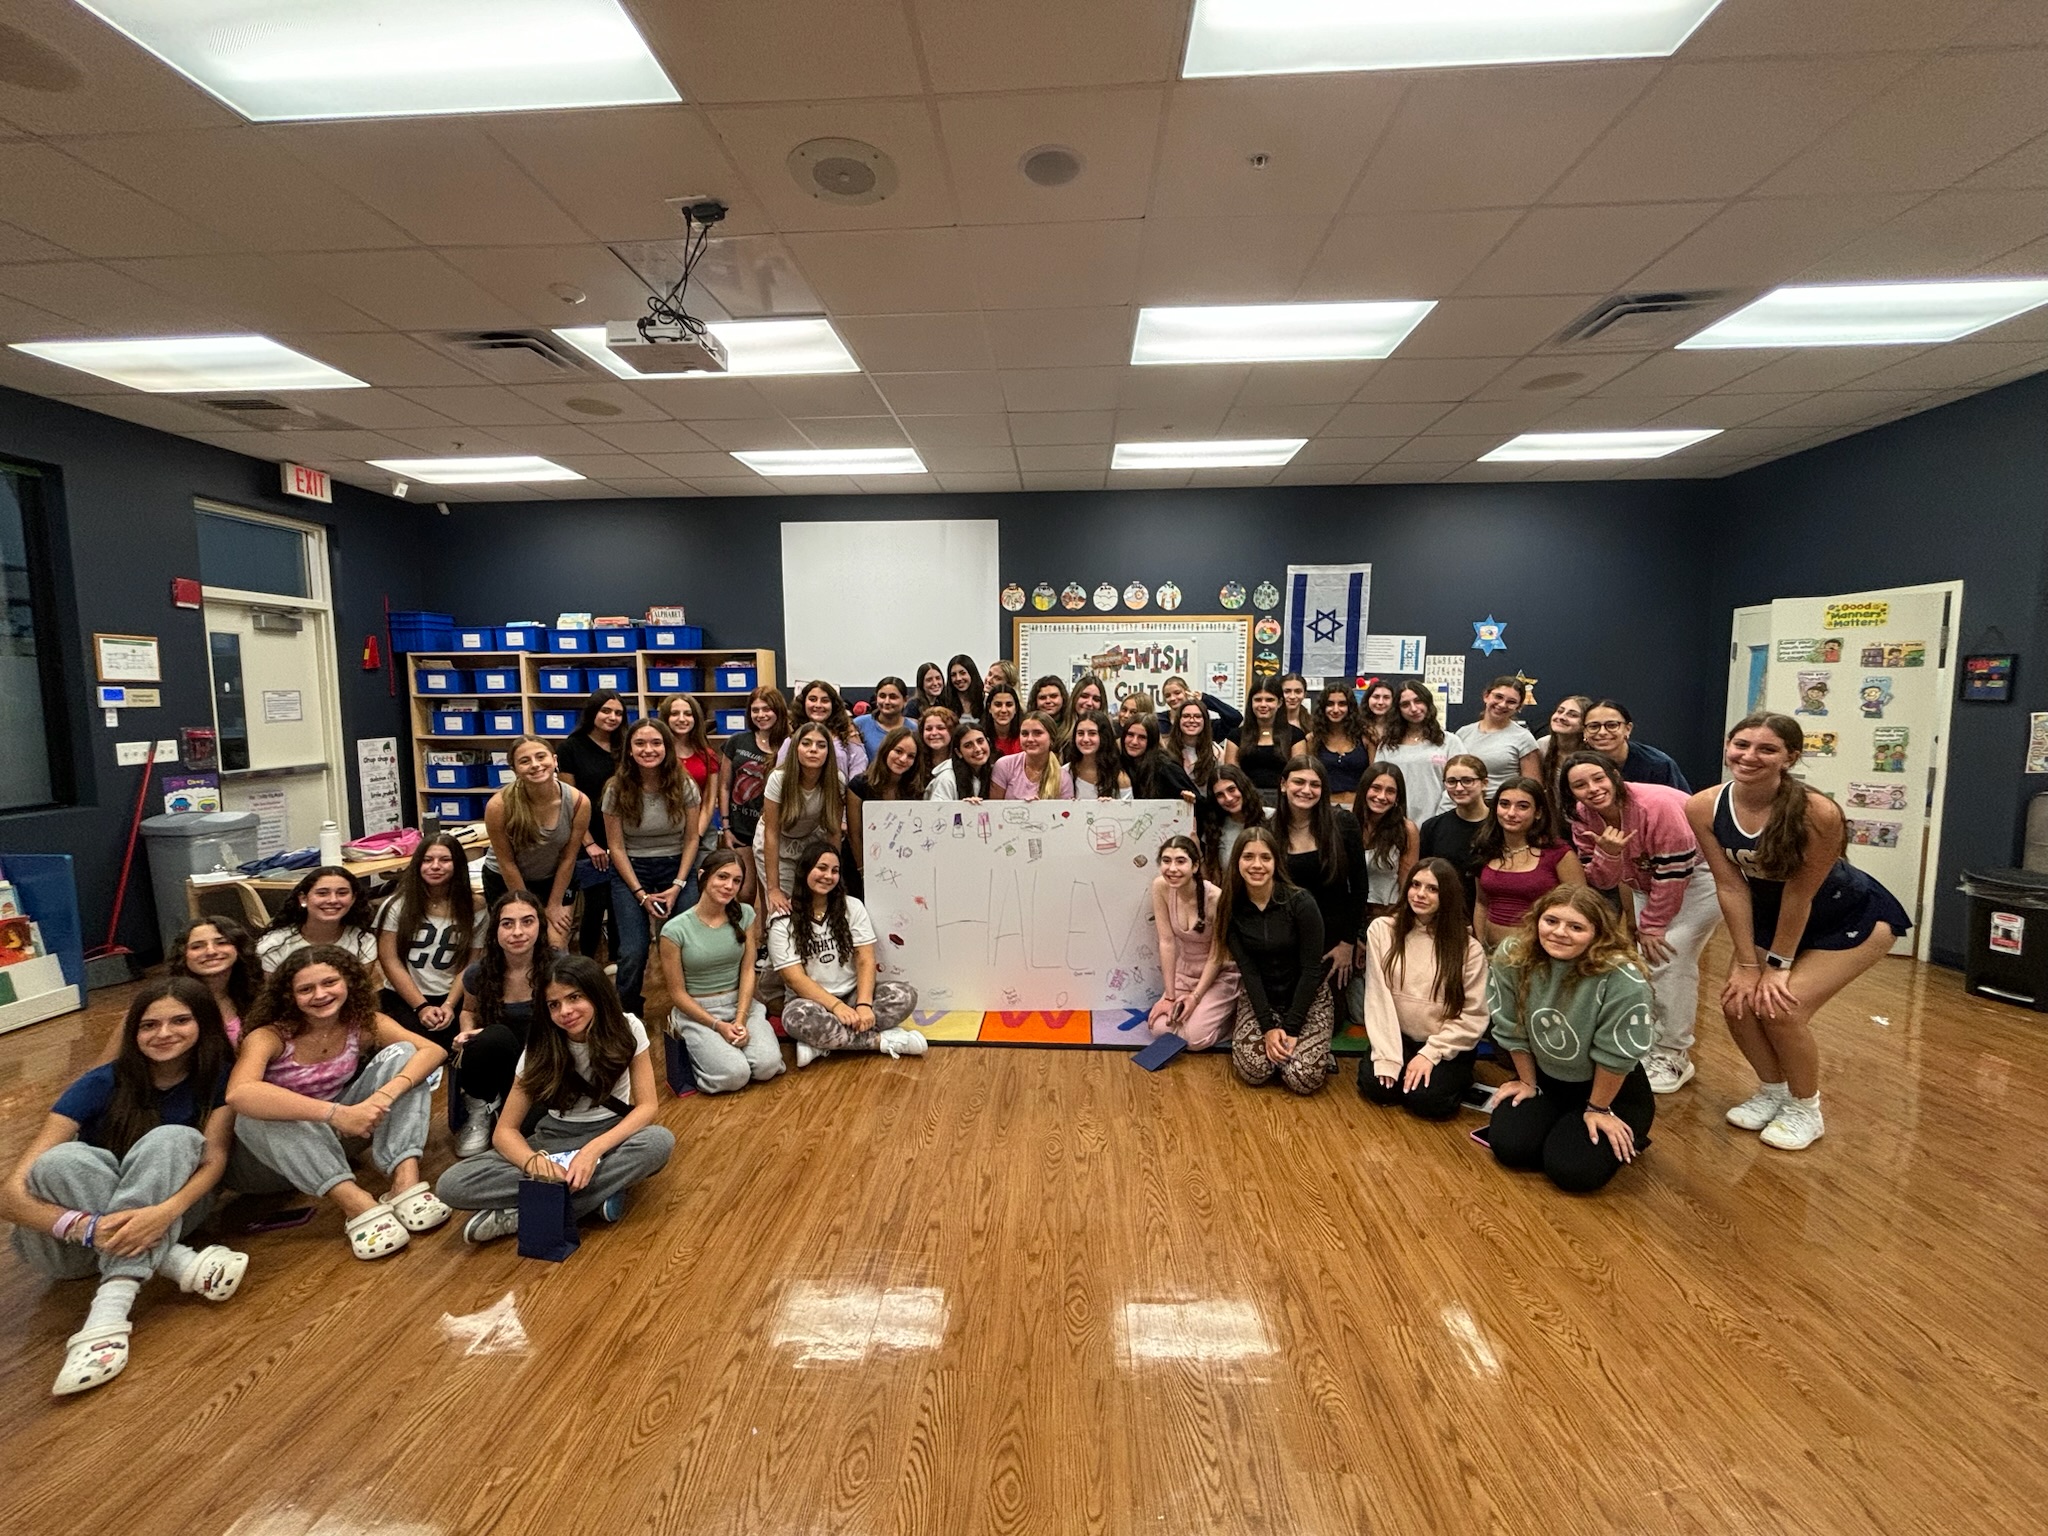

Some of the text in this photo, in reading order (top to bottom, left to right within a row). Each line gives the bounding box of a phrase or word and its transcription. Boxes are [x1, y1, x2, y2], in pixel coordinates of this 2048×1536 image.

[295, 467, 326, 498] EXIT
[1841, 603, 1872, 611] Good
[654, 610, 681, 618] ALPHABET
[1831, 610, 1881, 620] Manners
[1833, 618, 1879, 628] Matter!
